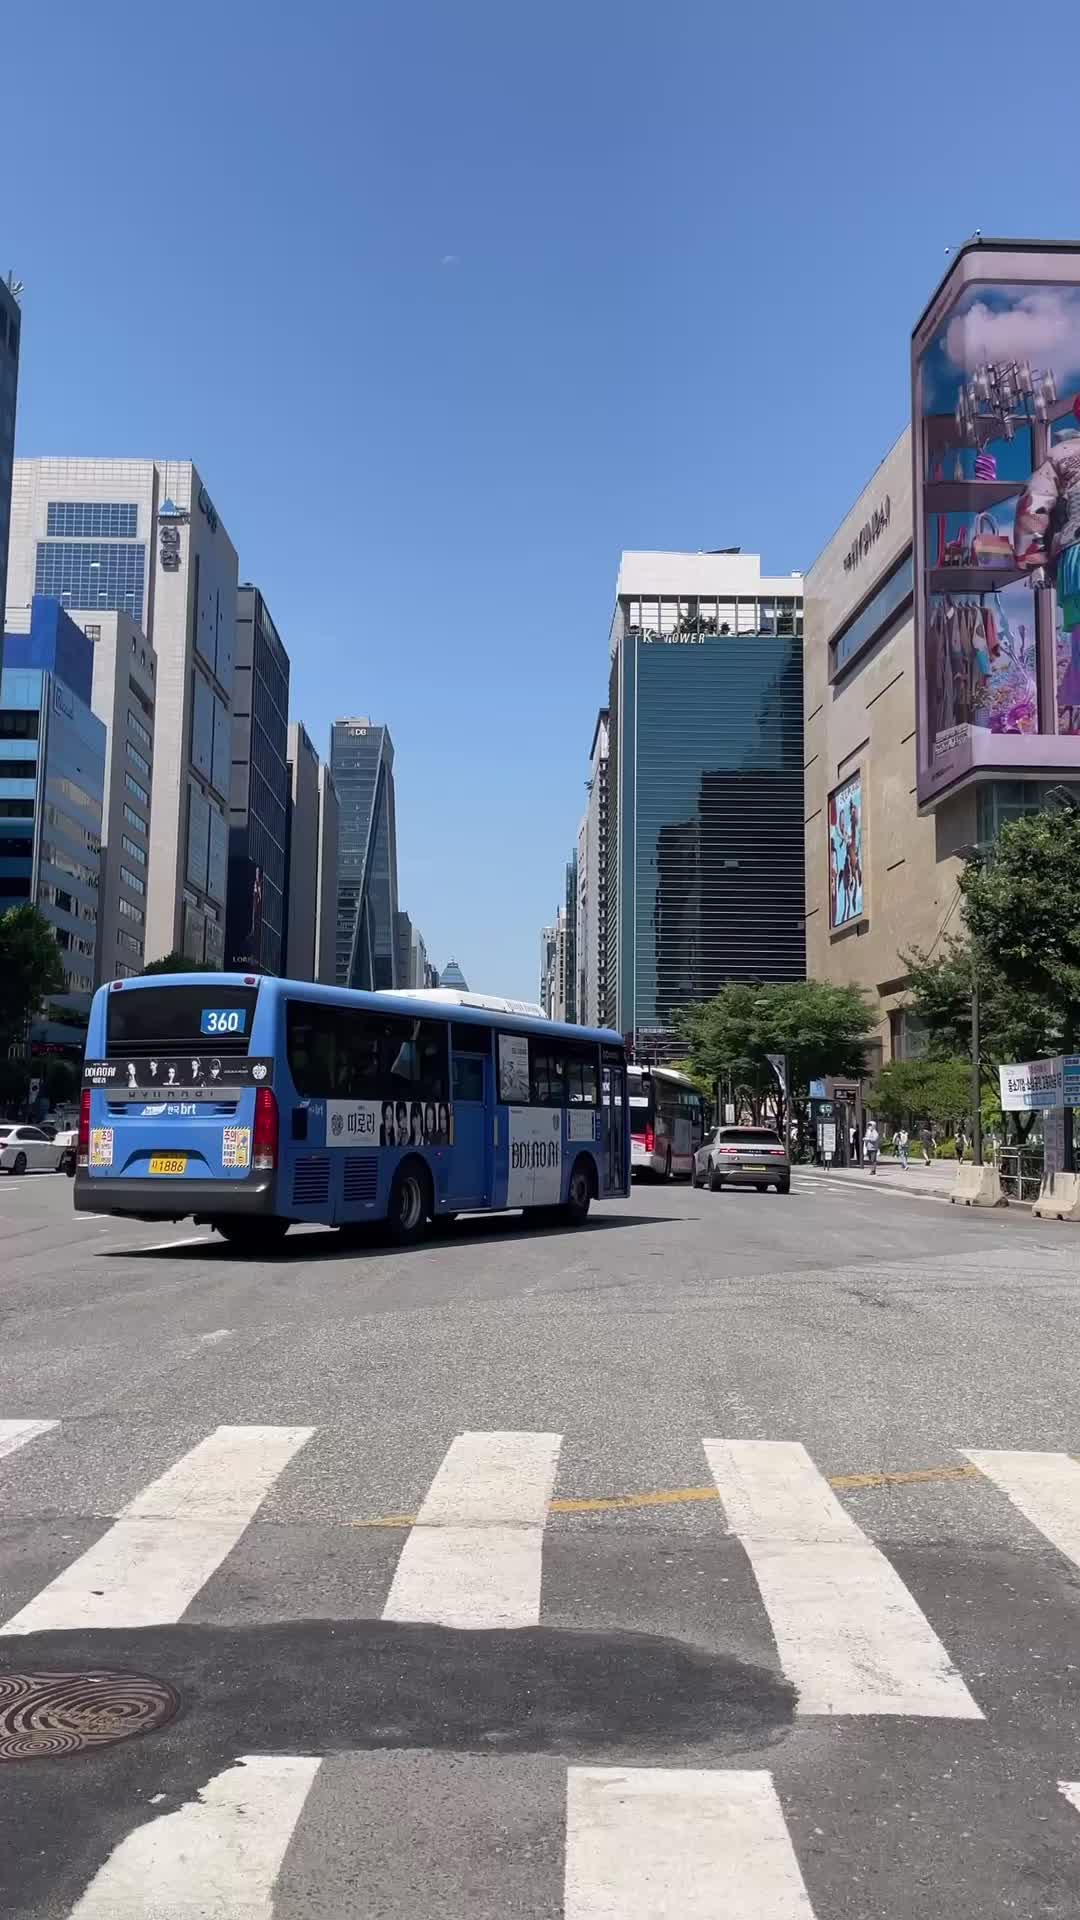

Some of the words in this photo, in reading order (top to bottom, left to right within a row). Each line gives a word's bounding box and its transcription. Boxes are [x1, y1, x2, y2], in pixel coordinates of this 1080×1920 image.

[664, 632, 705, 644] TOWER
[207, 1012, 239, 1031] 360
[224, 1130, 236, 1143] 주의
[160, 1160, 184, 1172] 1886
